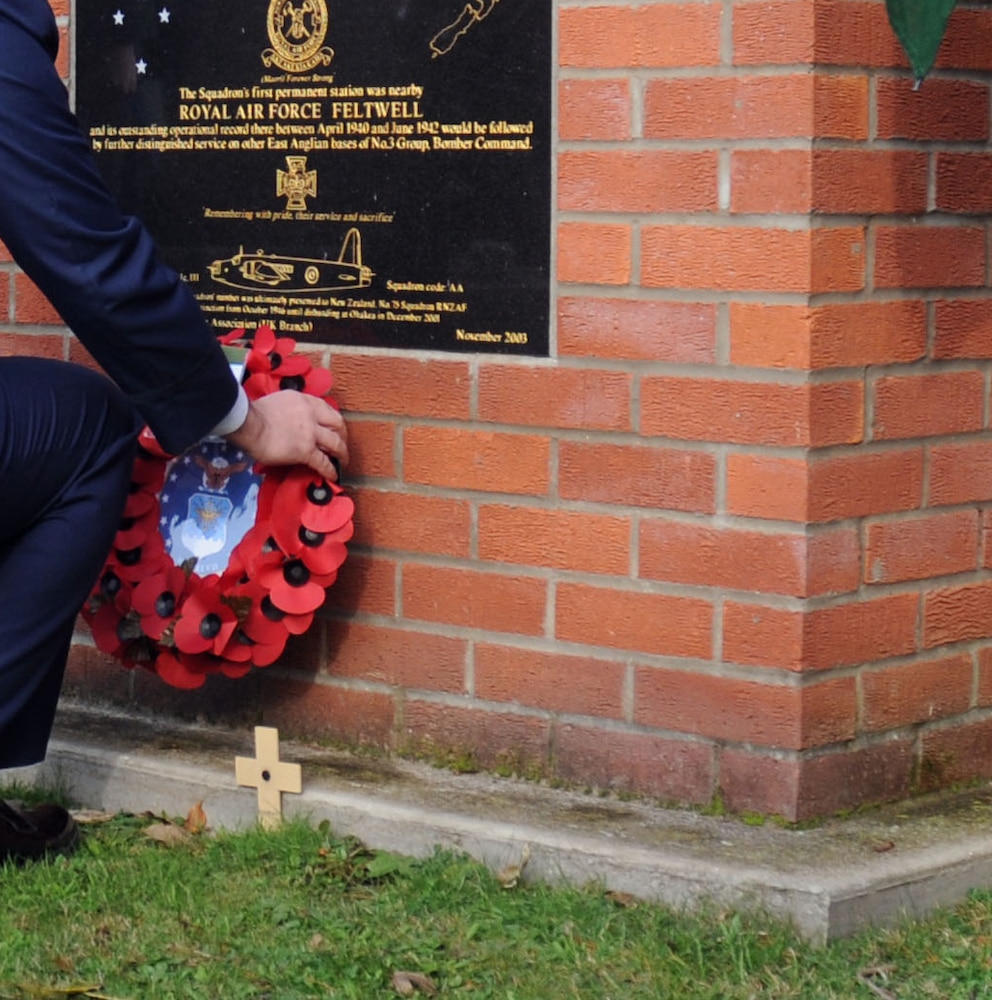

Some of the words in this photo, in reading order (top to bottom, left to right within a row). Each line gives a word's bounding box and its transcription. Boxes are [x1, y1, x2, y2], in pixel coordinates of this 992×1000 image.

[179, 87, 197, 99] The
[199, 87, 250, 102] Squadron's
[252, 86, 273, 98] first
[275, 87, 328, 101] permanent
[329, 84, 364, 97] station
[366, 86, 386, 96] was
[388, 83, 424, 98] nearby
[179, 104, 232, 120] ROYAL
[235, 103, 264, 119] AIR
[269, 102, 322, 119] FORCE
[332, 101, 424, 119] FELTWELL
[90, 124, 105, 136] and
[107, 124, 117, 136] its
[118, 124, 168, 138] outstanding
[169, 123, 218, 138] operational
[220, 123, 249, 135] record
[250, 123, 274, 135] there
[276, 123, 315, 134] between
[317, 122, 344, 137] April
[347, 122, 369, 134] 1940
[371, 122, 390, 134] and
[391, 122, 414, 134] June
[417, 121, 439, 134] 1942
[441, 121, 472, 134] would
[474, 121, 487, 134] be
[489, 121, 533, 134] followed
[92, 138, 102, 152] by
[104, 138, 134, 150] further
[135, 138, 193, 152] distinguished
[195, 137, 226, 149] service
[228, 140, 240, 149] on
[241, 137, 265, 149] other
[268, 136, 288, 149] East
[290, 136, 329, 151] Anglian
[331, 137, 357, 149] bases
[358, 137, 370, 149] of
[396, 137, 430, 152] Group,
[433, 136, 473, 149] Bomber
[474, 136, 533, 150] Command.
[256, 210, 272, 219] with
[295, 210, 314, 221] their
[314, 211, 342, 221] service
[343, 212, 358, 222] and
[387, 280, 425, 293] Squadron
[330, 297, 346, 306] New
[401, 300, 435, 311] Squadron
[436, 302, 468, 312] RNZAF
[386, 312, 422, 322] December
[211, 318, 257, 329] Association
[279, 321, 313, 332] Branch)
[456, 329, 502, 342] November
[504, 331, 528, 344] 2003
